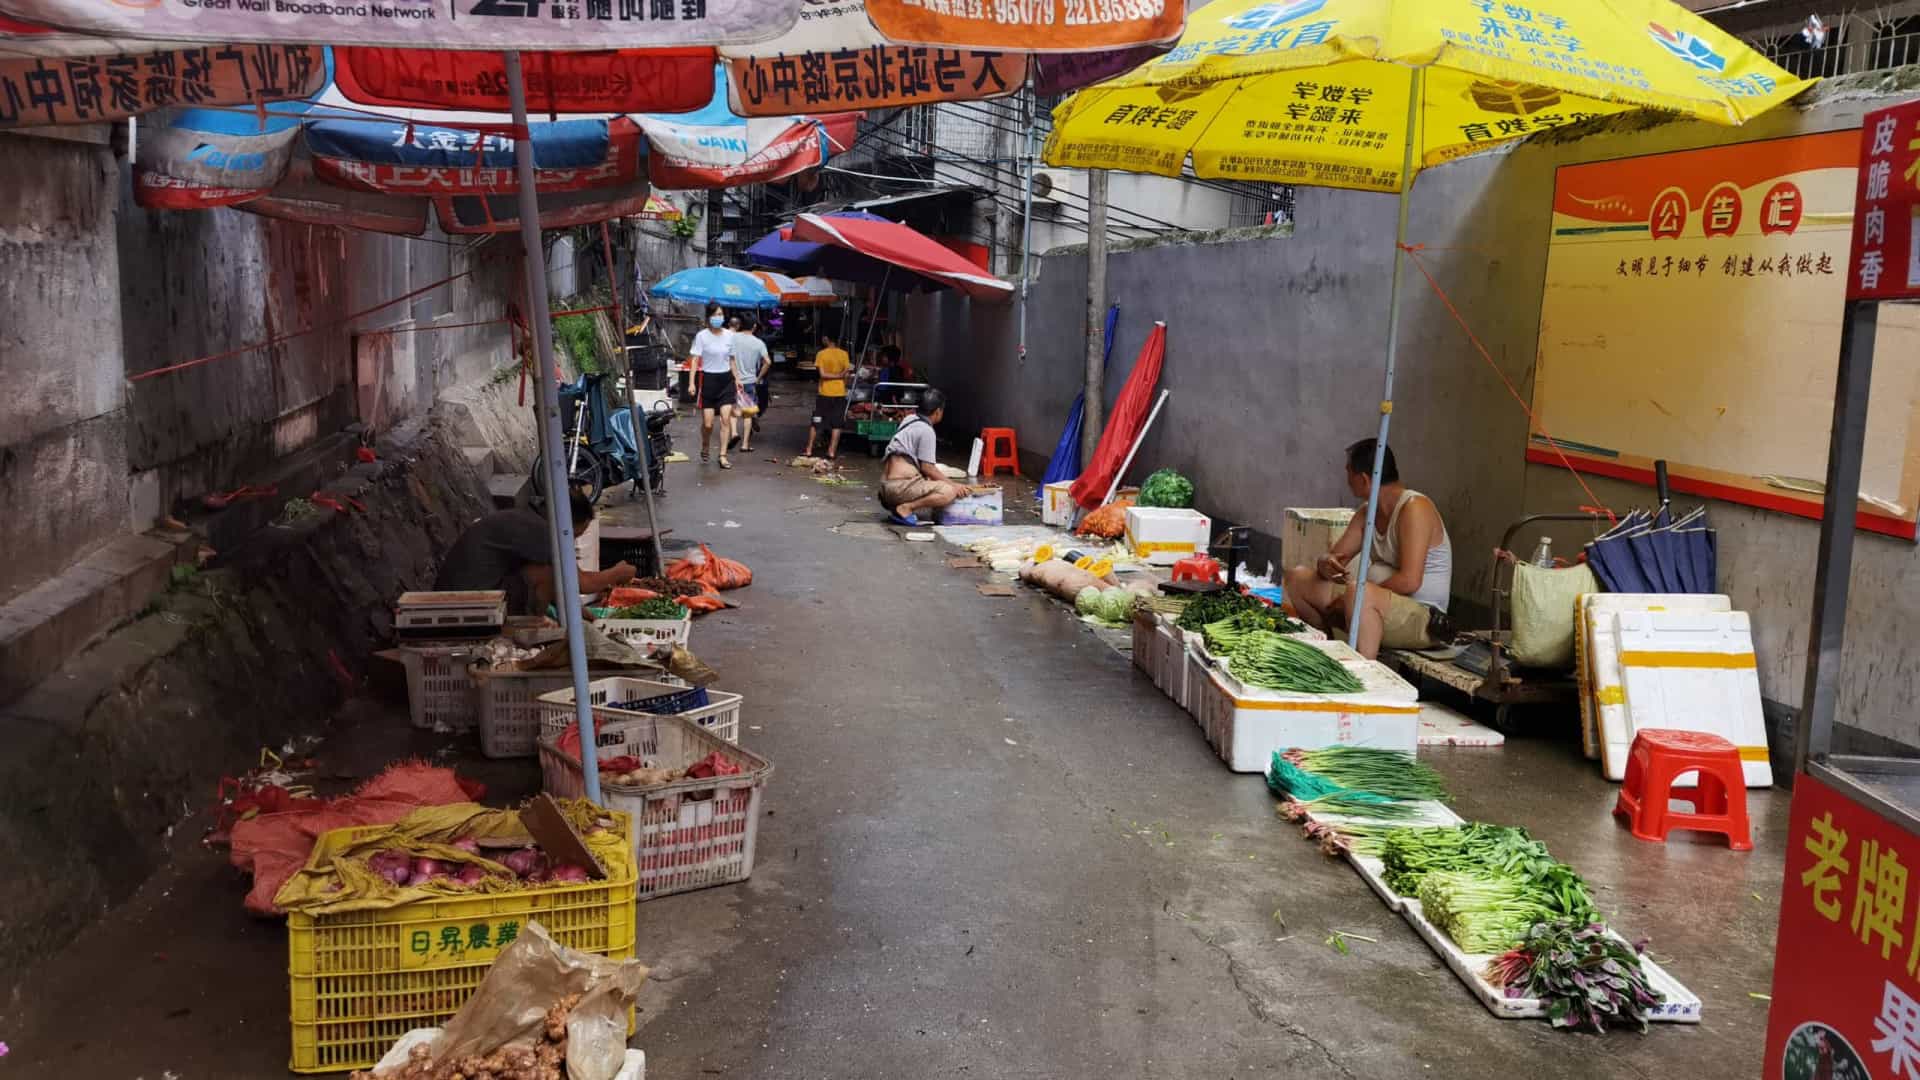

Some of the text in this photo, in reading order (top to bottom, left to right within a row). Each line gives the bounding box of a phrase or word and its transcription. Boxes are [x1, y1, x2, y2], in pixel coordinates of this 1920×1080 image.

[237, 0, 271, 12] Wall
[275, 0, 367, 17] Broadband
[371, 4, 436, 20] Network
[1657, 190, 1796, 233] 公告栏
[1859, 114, 1897, 290] 皮脆肉香
[1615, 251, 1835, 279] 文明见于细节 创建从我做起
[1801, 810, 1920, 983] 老牌
[412, 921, 520, 953] 日昇農業
